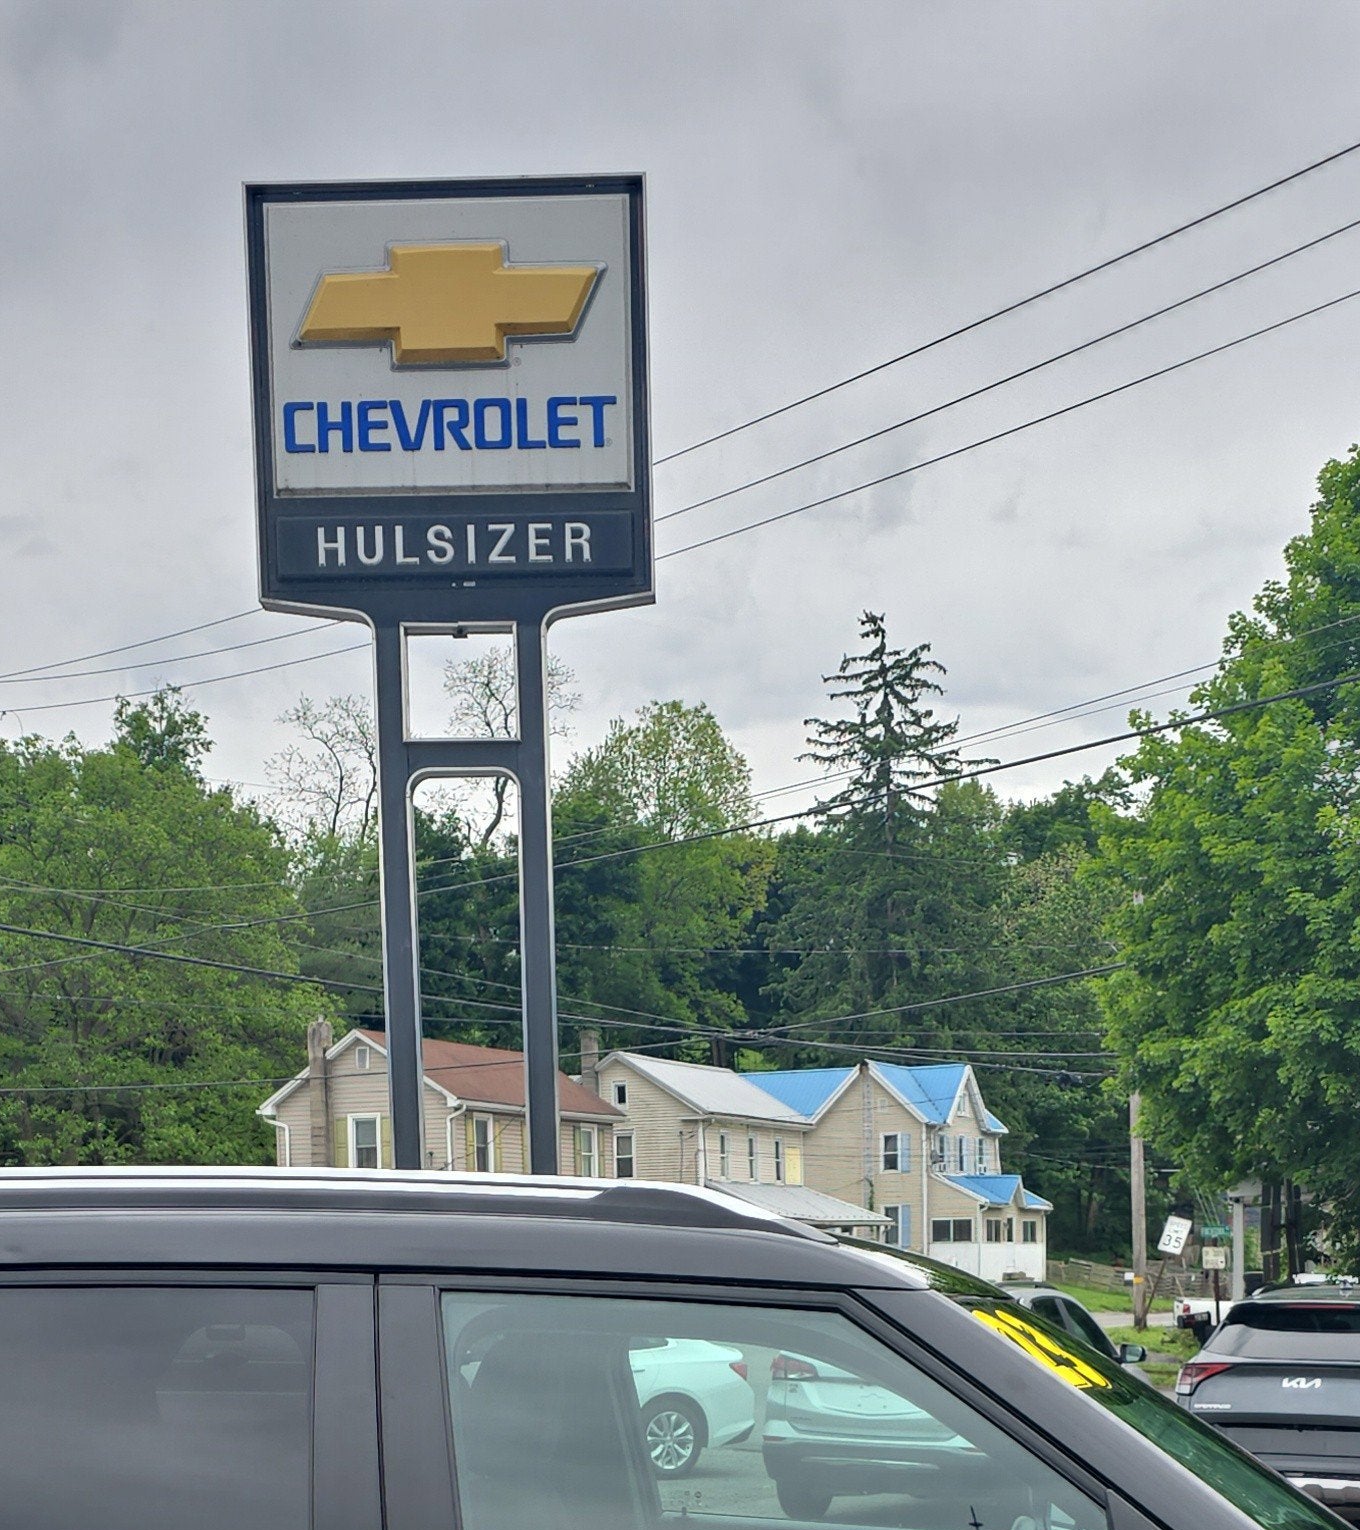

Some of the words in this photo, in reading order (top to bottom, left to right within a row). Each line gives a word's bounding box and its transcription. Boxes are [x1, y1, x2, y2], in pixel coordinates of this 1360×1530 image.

[283, 395, 617, 454] CHEVROLET
[317, 522, 592, 567] HULSIZER
[1162, 1234, 1183, 1249] 35
